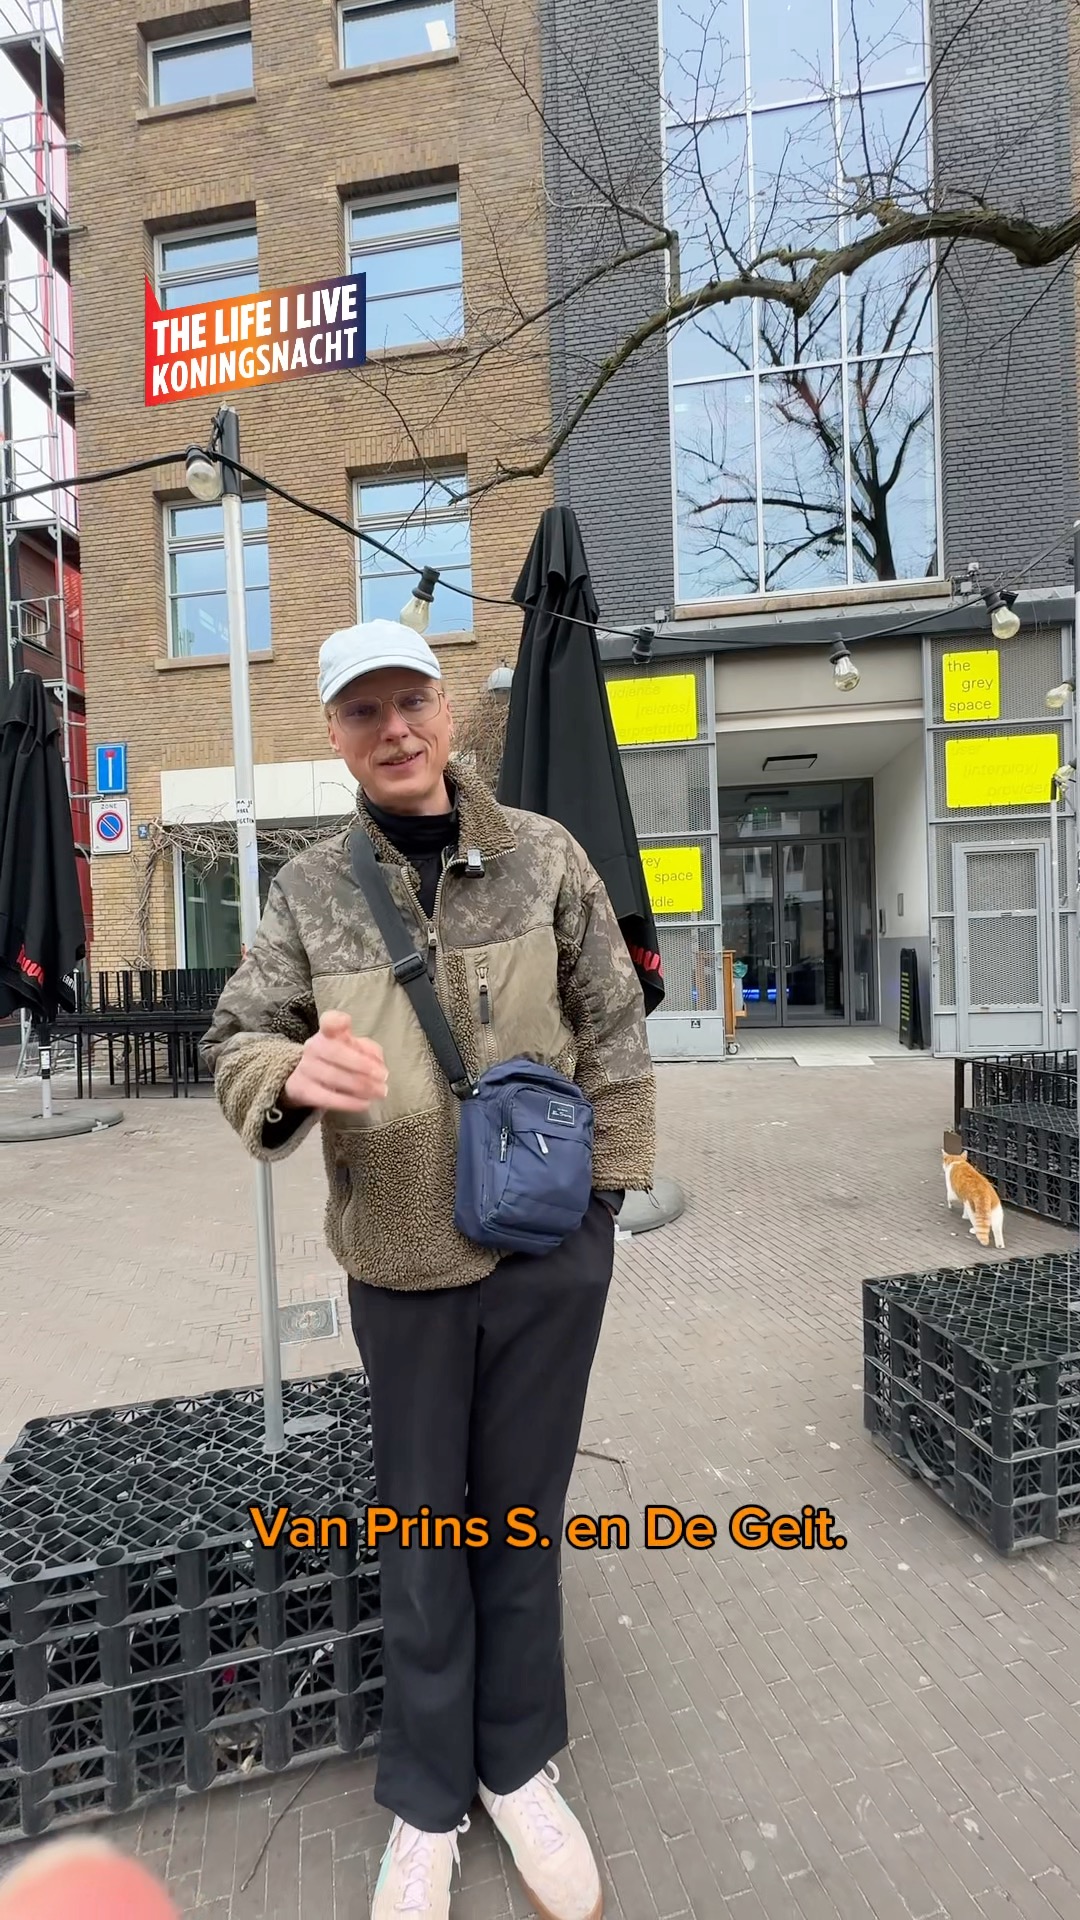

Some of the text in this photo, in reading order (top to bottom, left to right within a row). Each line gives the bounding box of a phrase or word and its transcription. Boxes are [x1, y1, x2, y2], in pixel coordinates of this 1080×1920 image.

[947, 659, 971, 673] the
[608, 684, 661, 699] udience
[961, 678, 994, 693] grey
[949, 700, 992, 714] space
[655, 871, 693, 884] space
